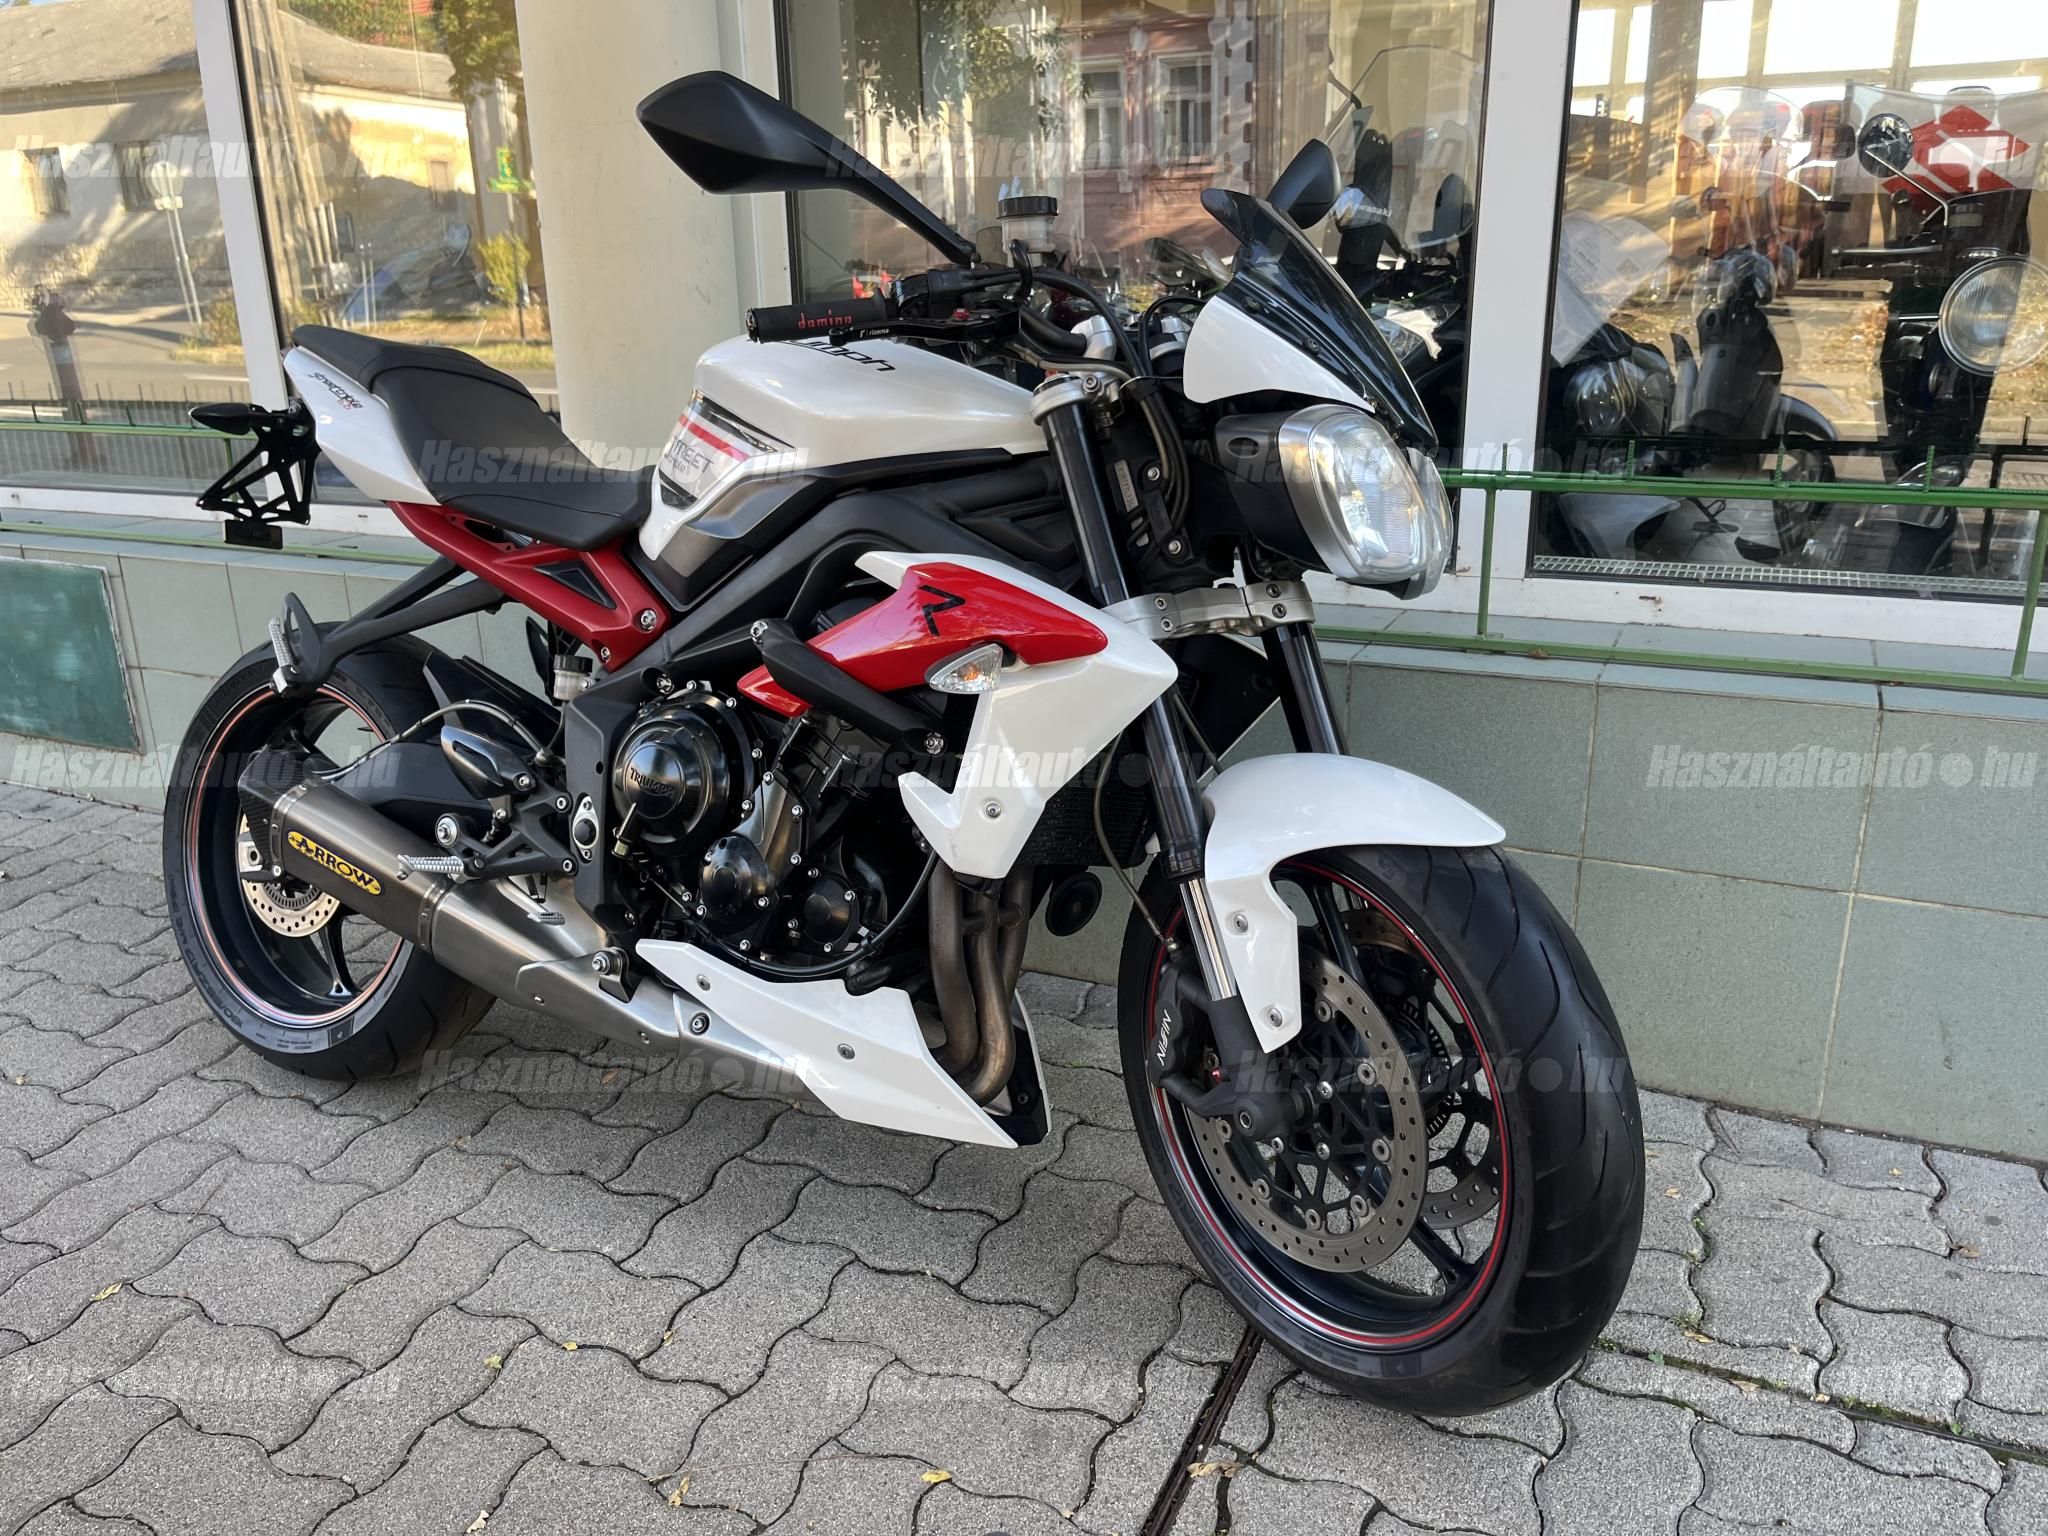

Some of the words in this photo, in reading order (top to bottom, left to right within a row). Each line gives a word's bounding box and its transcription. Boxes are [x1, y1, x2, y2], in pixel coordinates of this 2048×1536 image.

[798, 308, 852, 329] domino
[630, 767, 676, 799] TRIUMPH
[295, 838, 374, 886] ARROW
